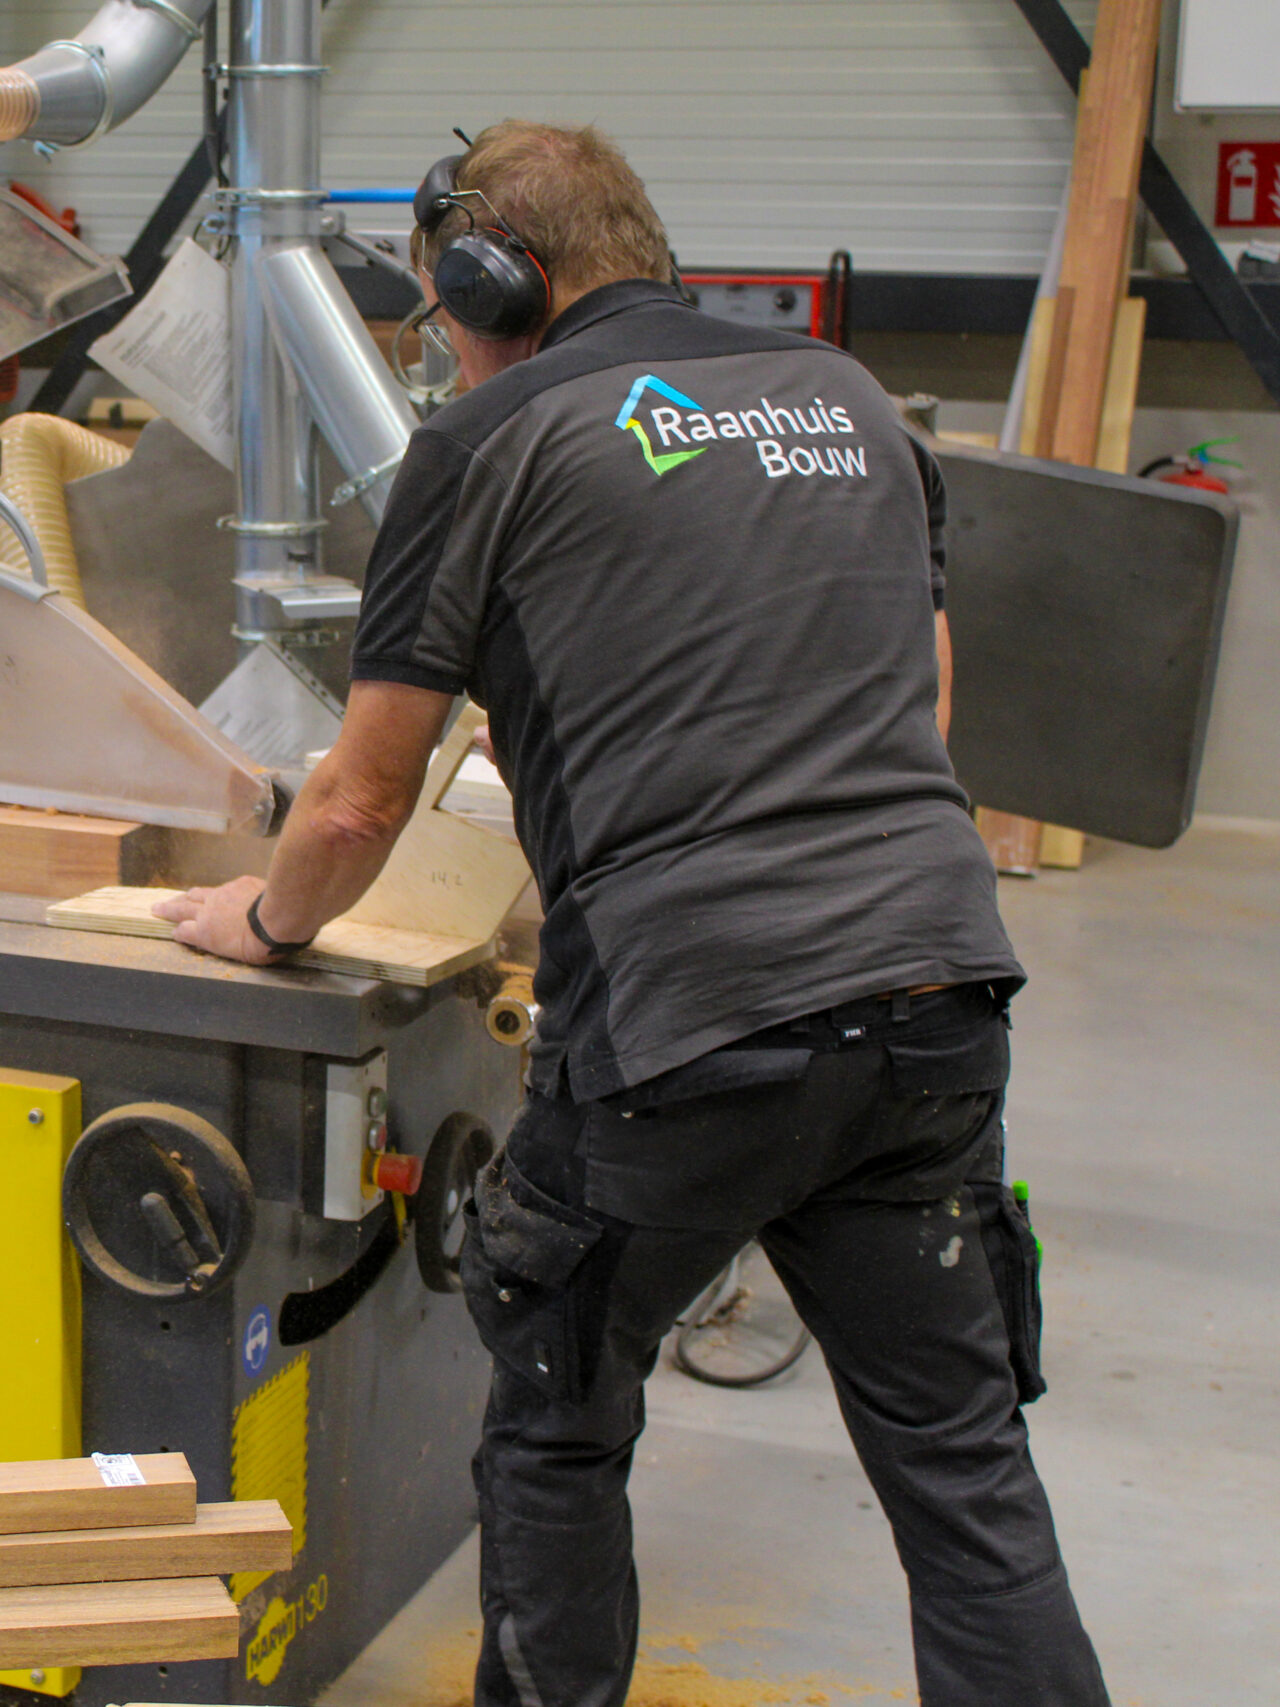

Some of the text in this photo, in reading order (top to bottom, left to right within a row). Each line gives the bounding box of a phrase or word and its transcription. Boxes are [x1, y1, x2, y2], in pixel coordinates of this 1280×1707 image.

[650, 397, 854, 446] Raanhuis
[756, 440, 868, 478] Bouw
[296, 1573, 328, 1630] 130
